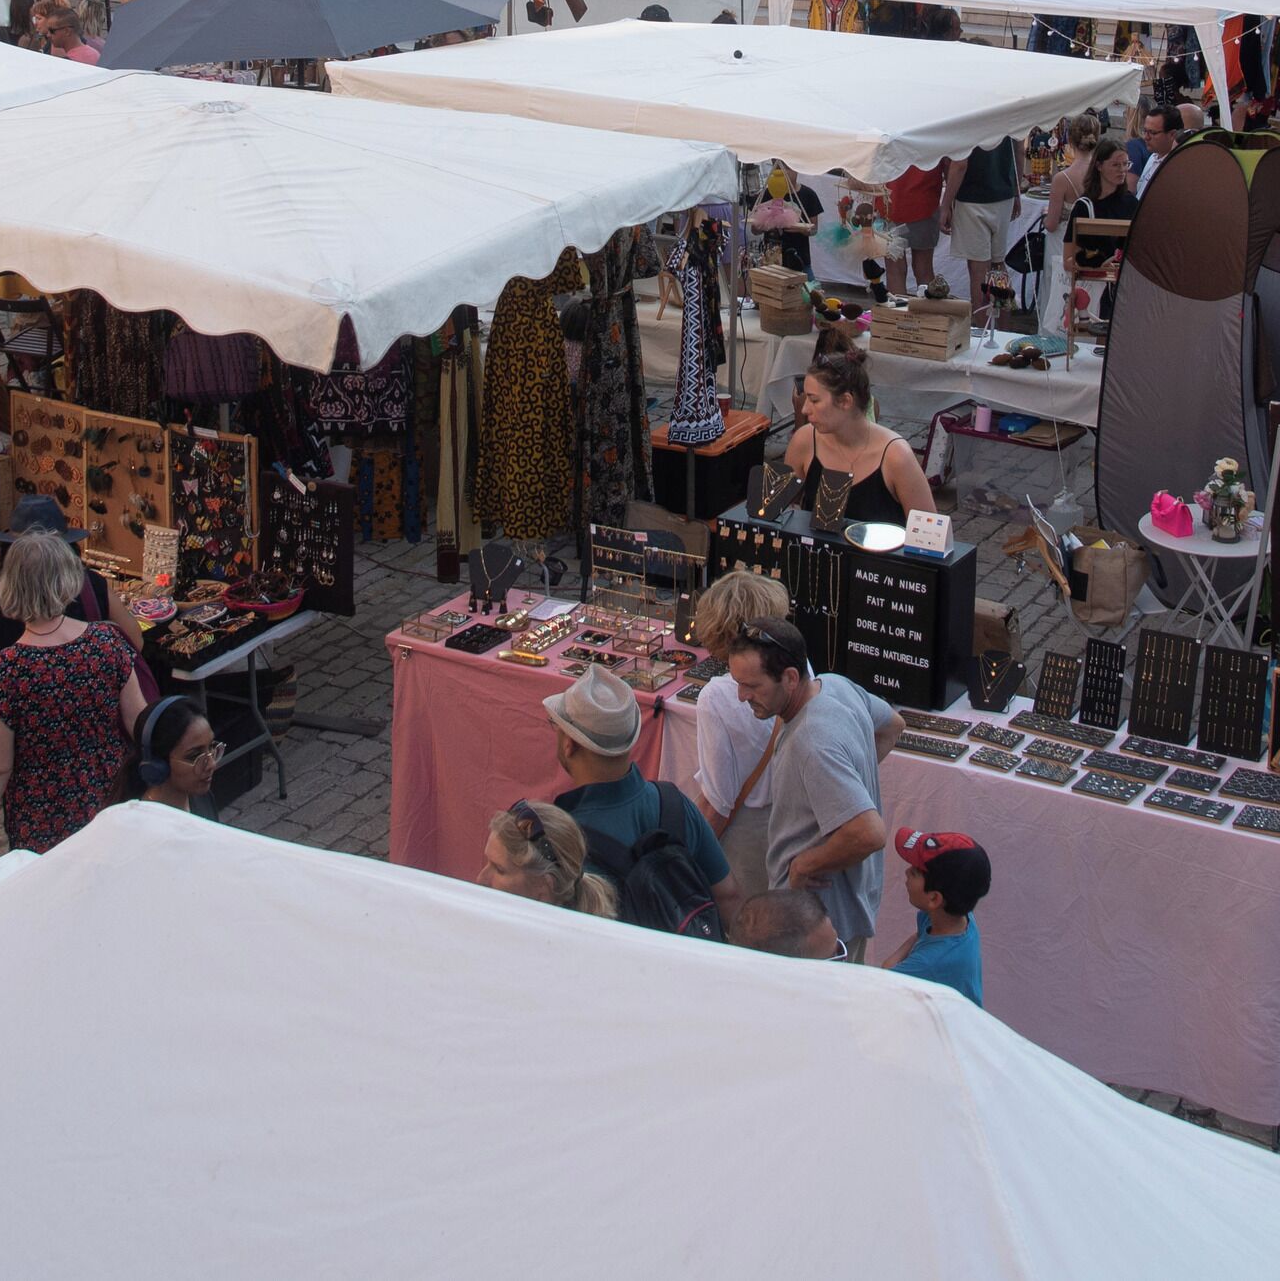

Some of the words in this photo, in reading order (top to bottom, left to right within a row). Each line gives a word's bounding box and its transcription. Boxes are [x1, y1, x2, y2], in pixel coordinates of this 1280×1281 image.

[855, 569, 880, 583] MADE
[899, 579, 927, 594] NIMES
[866, 595, 886, 607] FAIT
[891, 601, 914, 615] MAIN
[856, 618, 878, 632] DORE
[880, 624, 886, 634] A
[908, 630, 922, 642] FIN
[847, 640, 880, 657] PIERRES
[882, 649, 930, 669] NATURELLES
[873, 674, 901, 689] SILMA
